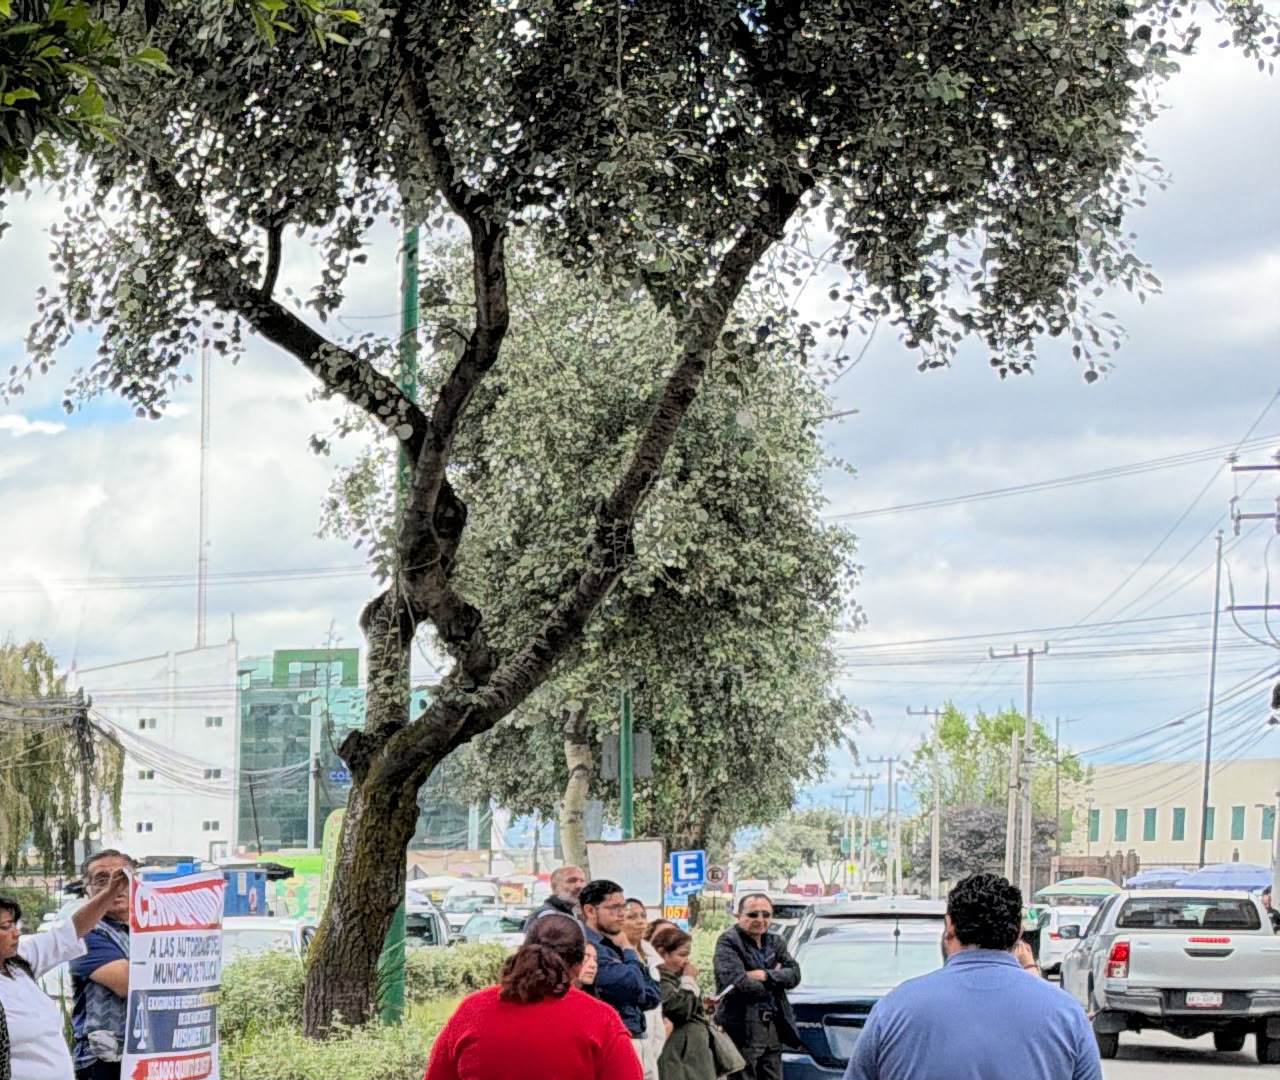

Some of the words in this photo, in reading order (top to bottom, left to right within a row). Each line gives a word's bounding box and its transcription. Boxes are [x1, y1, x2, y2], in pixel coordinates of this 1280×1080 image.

[678, 854, 699, 880] E
[149, 938, 157, 958] A
[159, 936, 174, 958] LAS
